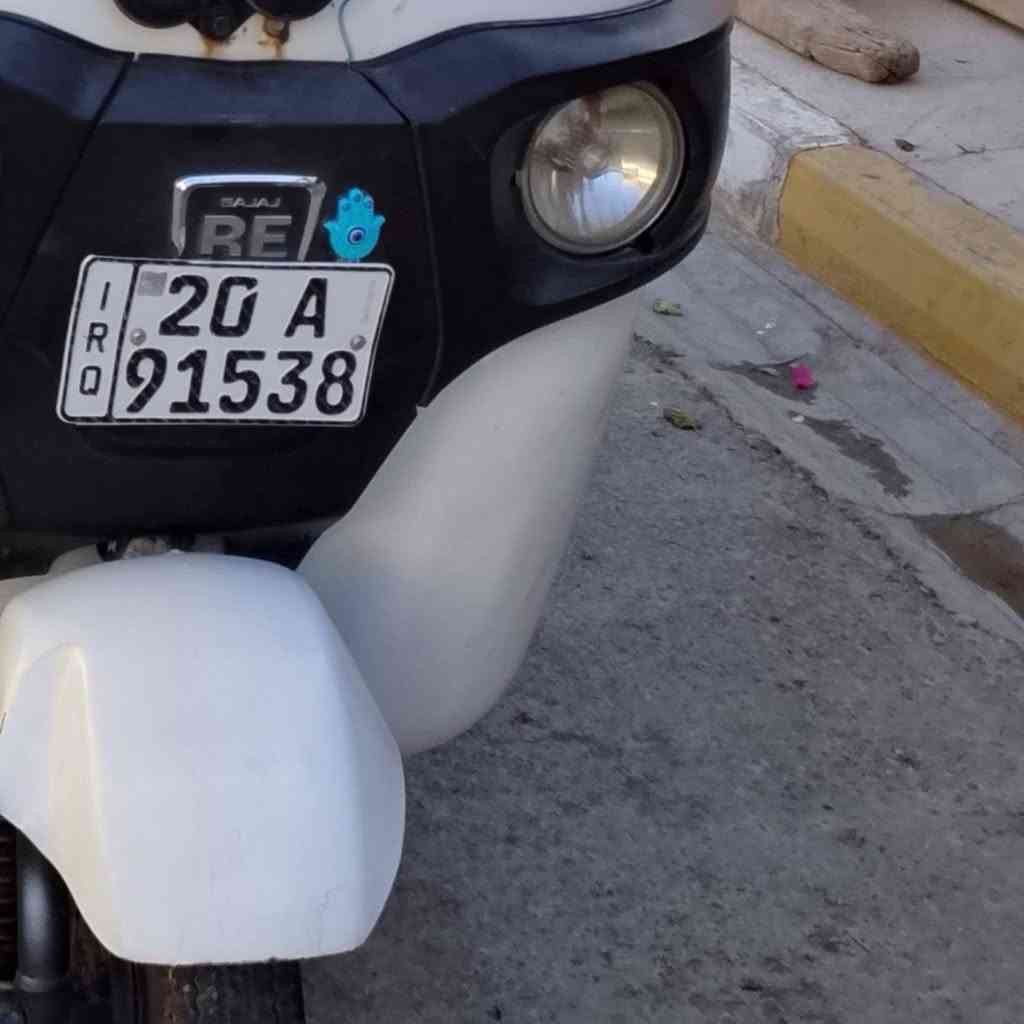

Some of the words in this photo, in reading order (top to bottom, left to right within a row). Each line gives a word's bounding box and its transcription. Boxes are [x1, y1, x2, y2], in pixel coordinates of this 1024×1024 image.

[199, 215, 292, 257] RE
[159, 275, 258, 337] 20
[284, 278, 327, 338] A
[126, 349, 356, 415] 91538
